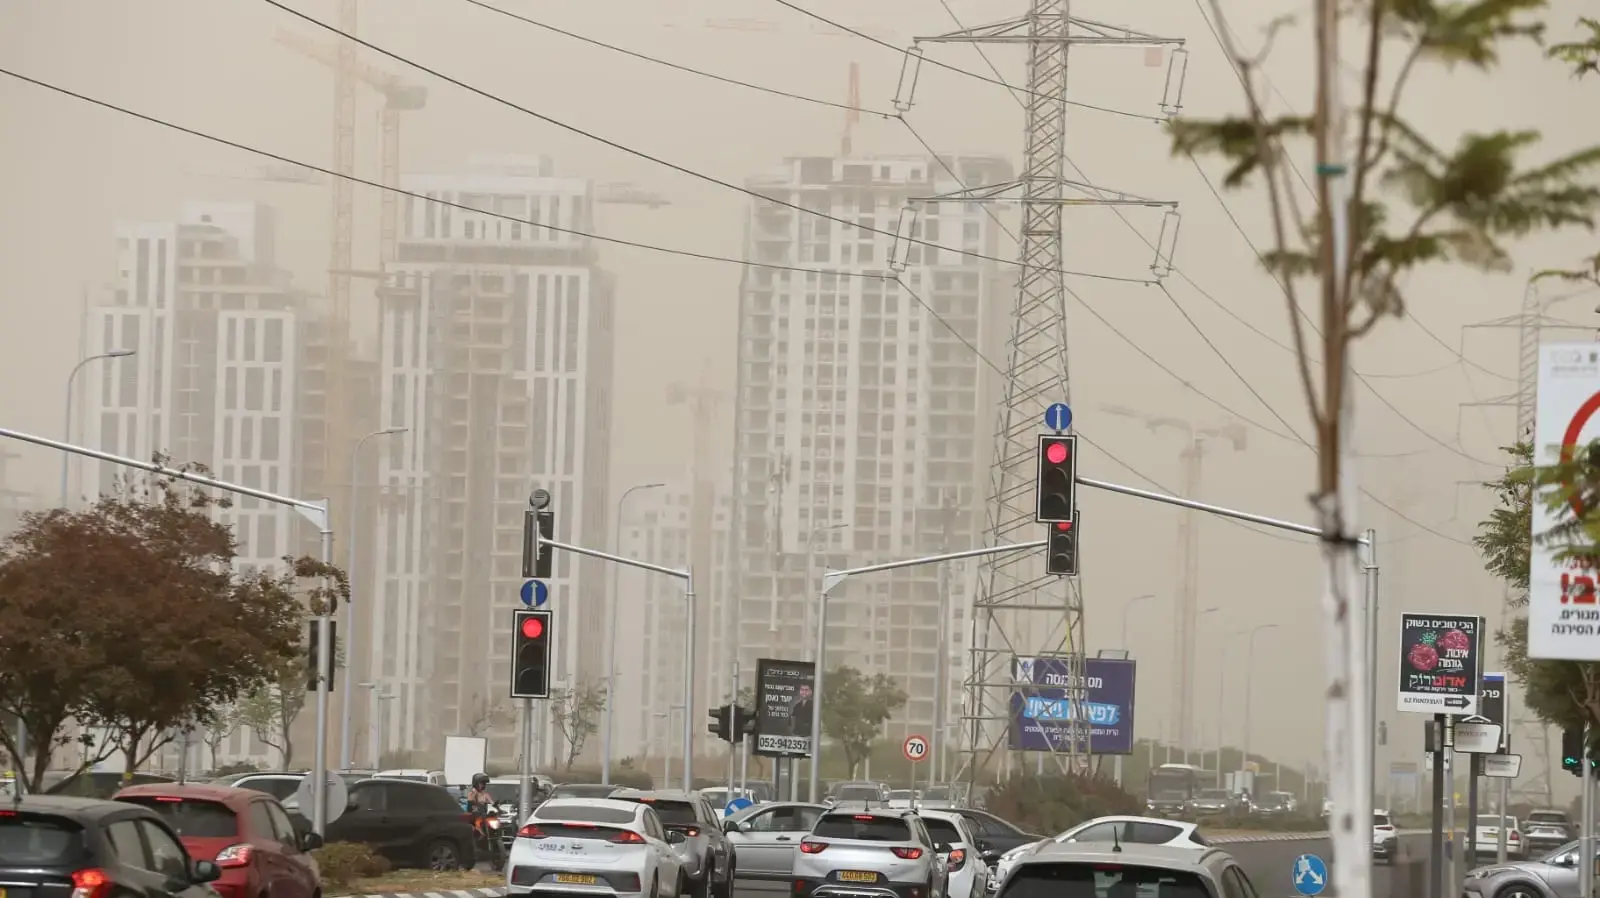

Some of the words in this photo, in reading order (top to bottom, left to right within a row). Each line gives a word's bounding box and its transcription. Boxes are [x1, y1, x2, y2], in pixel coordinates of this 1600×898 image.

[1406, 618, 1431, 629] בשוק
[1432, 619, 1457, 629] טובים
[1459, 621, 1474, 629] הכי
[1552, 624, 1593, 636] הסירנה
[1445, 648, 1469, 658] איכות
[1438, 658, 1463, 668] גורמה
[909, 743, 923, 754] 70
